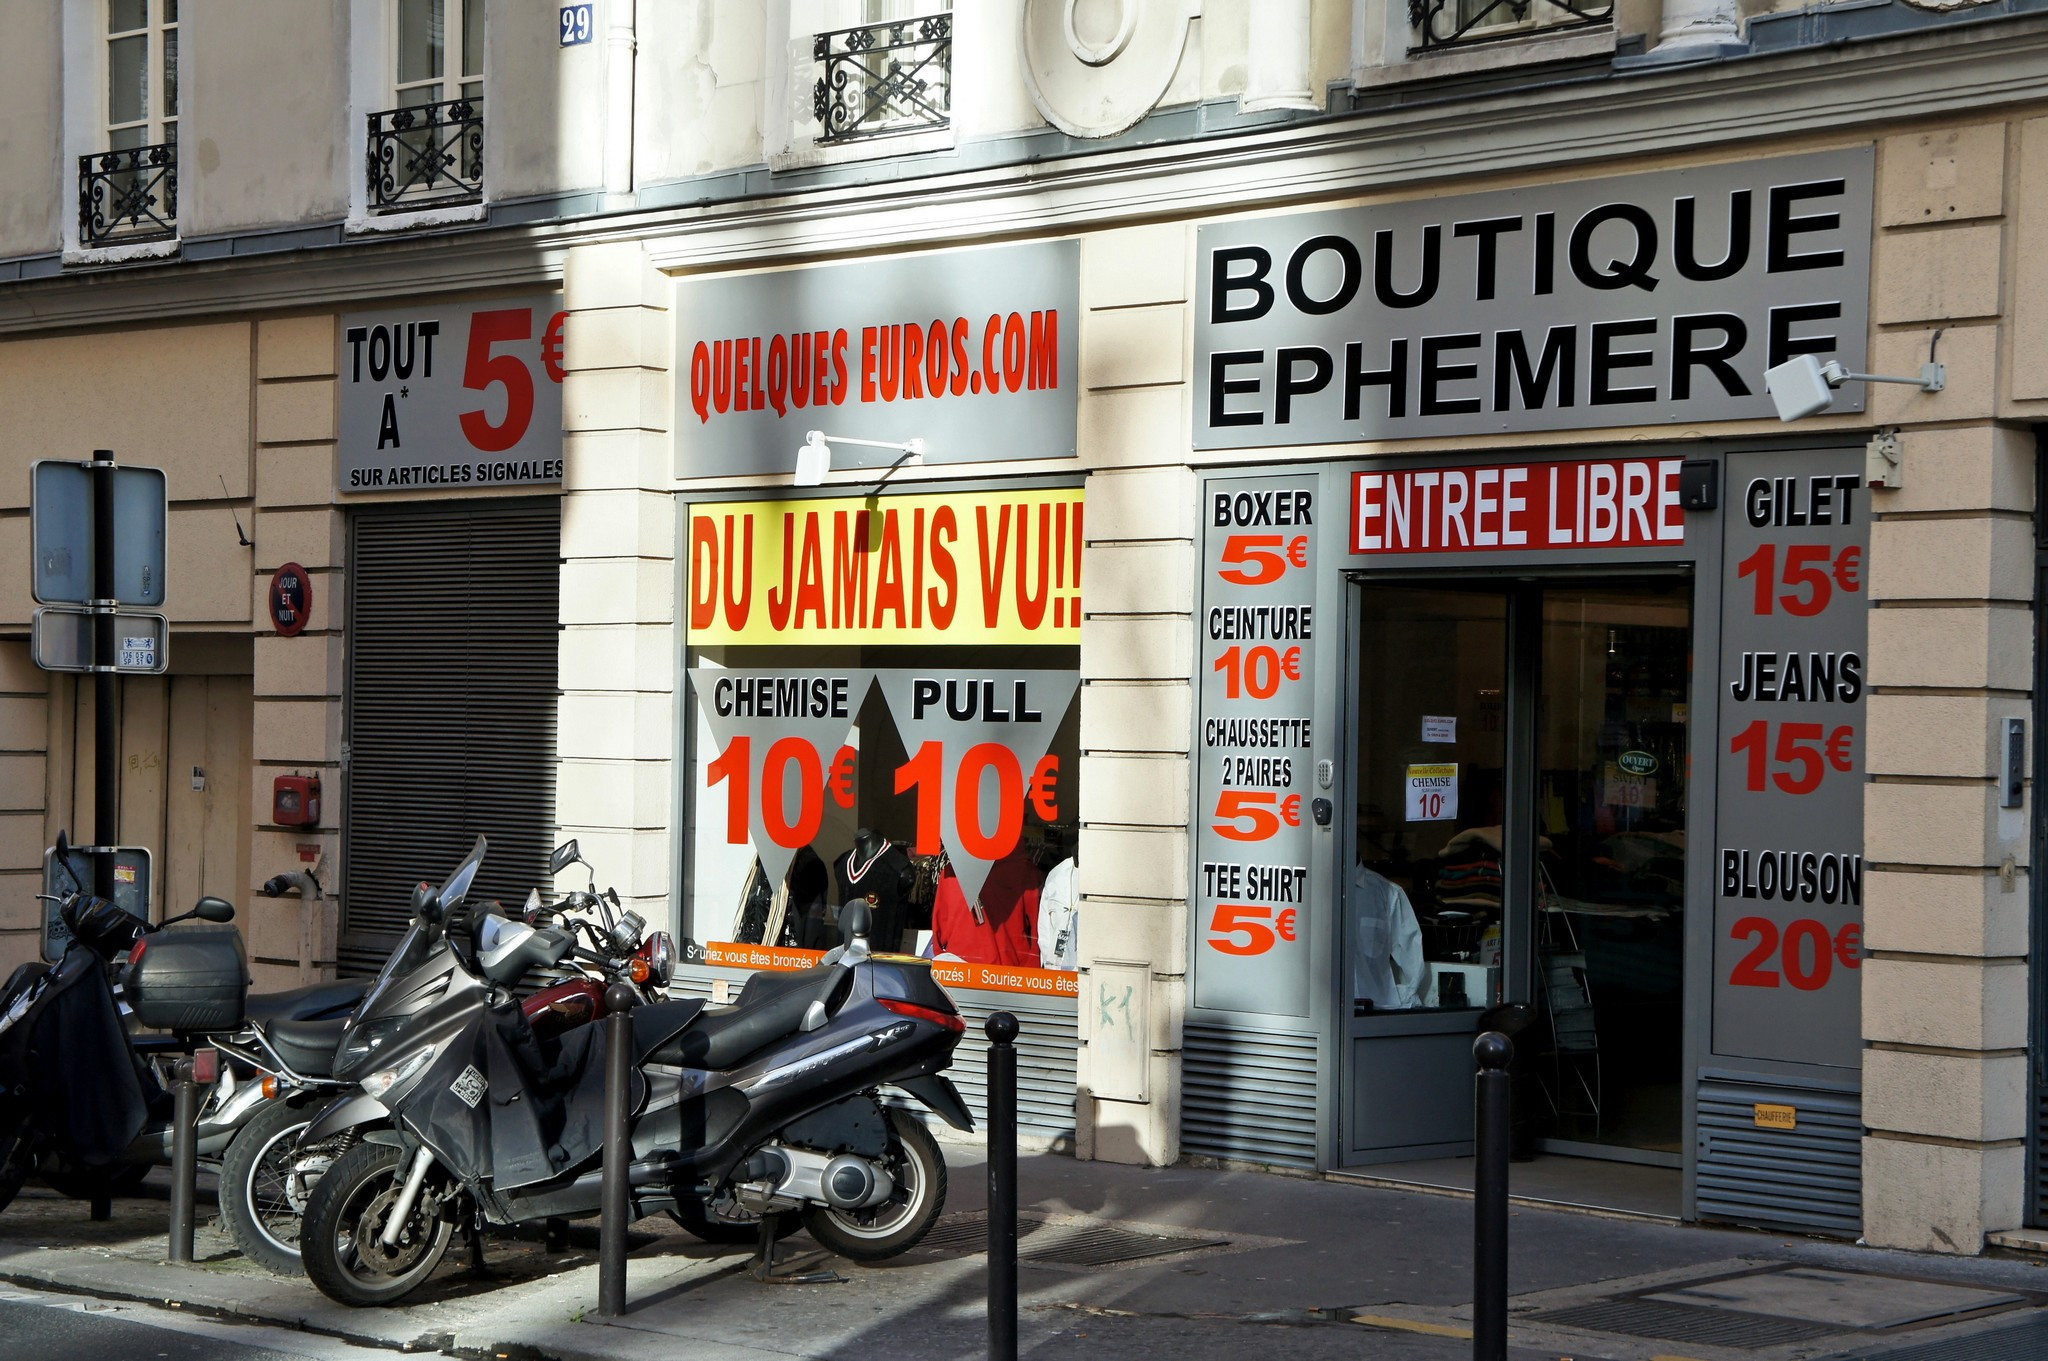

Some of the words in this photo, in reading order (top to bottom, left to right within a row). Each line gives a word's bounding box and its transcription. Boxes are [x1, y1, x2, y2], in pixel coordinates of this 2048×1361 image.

[562, 7, 590, 43] 29
[1209, 177, 1846, 325] BOUTIQUE
[347, 320, 440, 383] TOUT
[691, 327, 847, 424] QUELQUES
[861, 309, 1059, 402] EUROS.COM
[1208, 301, 1842, 428] EPHEMERE
[350, 468, 383, 487] SUR
[387, 463, 472, 485] ARTICLES
[476, 459, 563, 482] SIGNALES
[1213, 489, 1313, 527] BOXER
[1357, 465, 1529, 550] ENTREE
[1548, 460, 1684, 545] LIBRE
[1744, 474, 1860, 528] GILET
[278, 577, 298, 589] JOUR
[691, 514, 754, 632] DU
[767, 505, 958, 632] JAMAIS
[975, 502, 1084, 631] VU!!
[1218, 535, 1308, 586] 5€
[1738, 544, 1862, 617] 15€
[278, 609, 295, 621] NUIT
[281, 593, 291, 605] ET
[1208, 605, 1312, 641] CEINTURE
[714, 676, 849, 718] CHEMISE
[1214, 646, 1302, 699] 10€
[1730, 651, 1861, 703] JEANS
[911, 678, 1042, 723] PULL
[1205, 717, 1311, 749] CHAUSSETTE
[1731, 720, 1853, 795] 15€
[1223, 757, 1232, 786] 2
[1236, 756, 1292, 787] PAIRES
[1412, 777, 1451, 787] CHEMISE
[1622, 755, 1654, 768] OUVERT
[707, 736, 857, 849] 10€
[894, 740, 1060, 861] 10€
[1211, 790, 1302, 842] 5€
[1203, 862, 1241, 898] TEE
[1246, 863, 1306, 903] SHIRT
[1721, 848, 1861, 906] BLOUSON
[1207, 905, 1297, 956] 5€
[1728, 916, 1862, 991] 20€
[724, 951, 748, 963] vous
[750, 950, 770, 966] êtes
[773, 953, 813, 970] bronzés
[931, 966, 965, 982] onzés
[981, 969, 1023, 987] Souriez
[1025, 977, 1053, 990] vous
[1056, 974, 1079, 993] êtes
